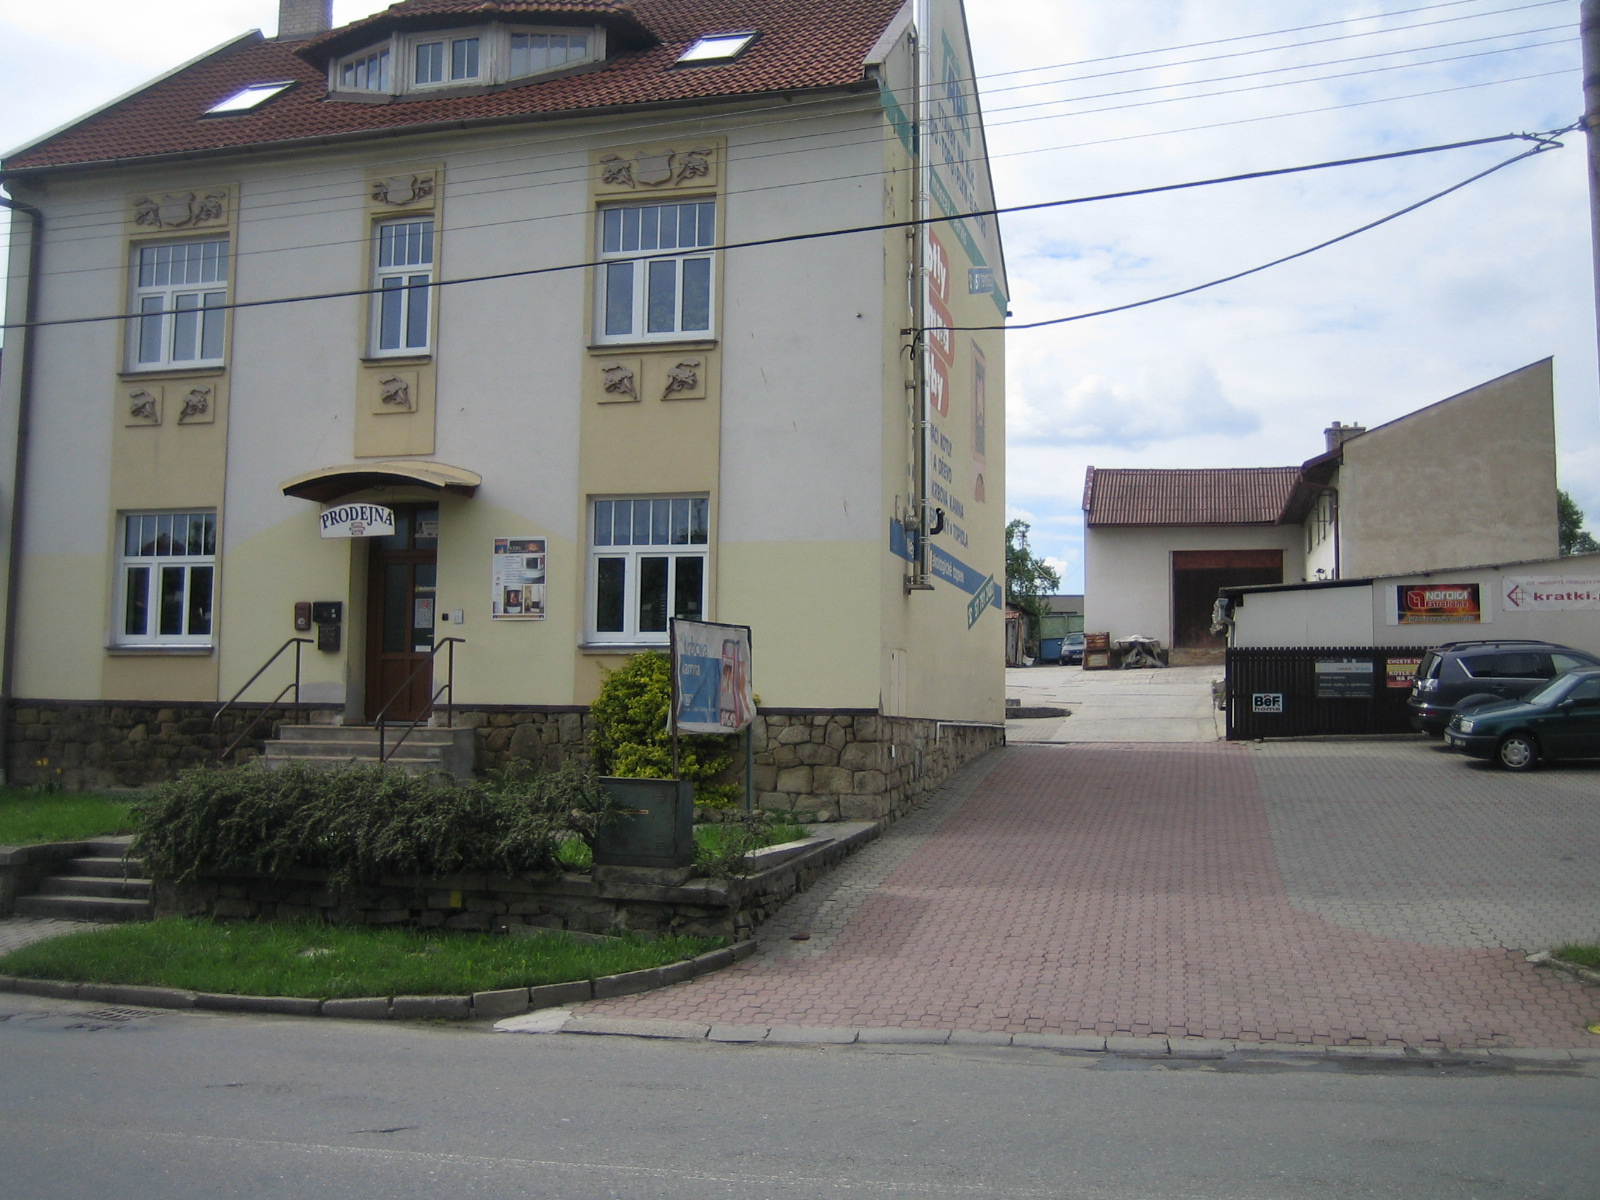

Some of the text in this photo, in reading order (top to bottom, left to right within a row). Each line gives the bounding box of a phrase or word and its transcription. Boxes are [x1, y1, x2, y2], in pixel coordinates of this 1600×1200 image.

[929, 242, 947, 300] otly
[321, 505, 394, 530] PRODEJNA
[1533, 591, 1600, 602] kratki.
